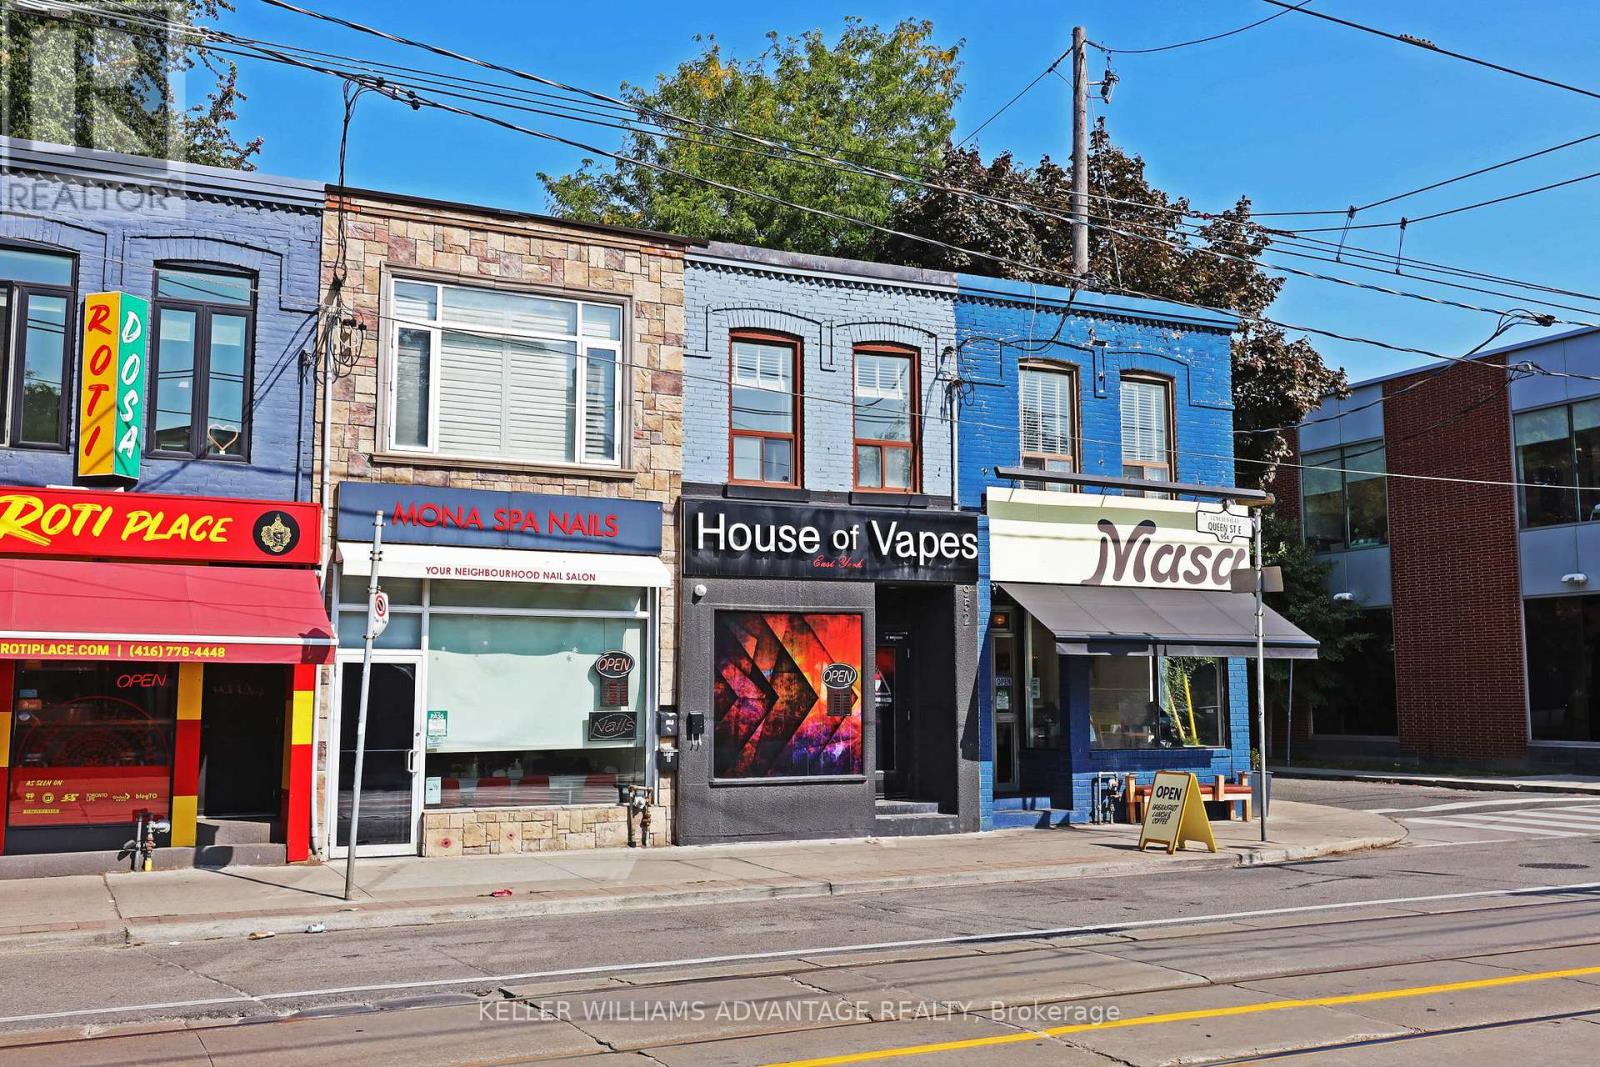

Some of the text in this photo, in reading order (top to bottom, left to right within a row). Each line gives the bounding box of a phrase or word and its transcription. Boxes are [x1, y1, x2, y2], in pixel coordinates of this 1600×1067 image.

[85, 304, 112, 457] ROTI
[118, 310, 142, 459] DOSA
[0, 494, 233, 547] ROTI PLACE
[391, 502, 619, 538] MONA SPA NAILS
[1208, 522, 1242, 535] QUEEN ST E
[697, 512, 978, 565] House of Vapes
[813, 555, 836, 568] East
[425, 566, 596, 581] YOUR NEIGHBOURHOOD NAIL SALON
[0, 643, 226, 658] ROTIPLACE.COM (416) 778-4448
[597, 657, 631, 671] OPEN
[117, 673, 167, 688] OPEN
[823, 669, 853, 683] OPEN
[1156, 785, 1182, 800] OPEN
